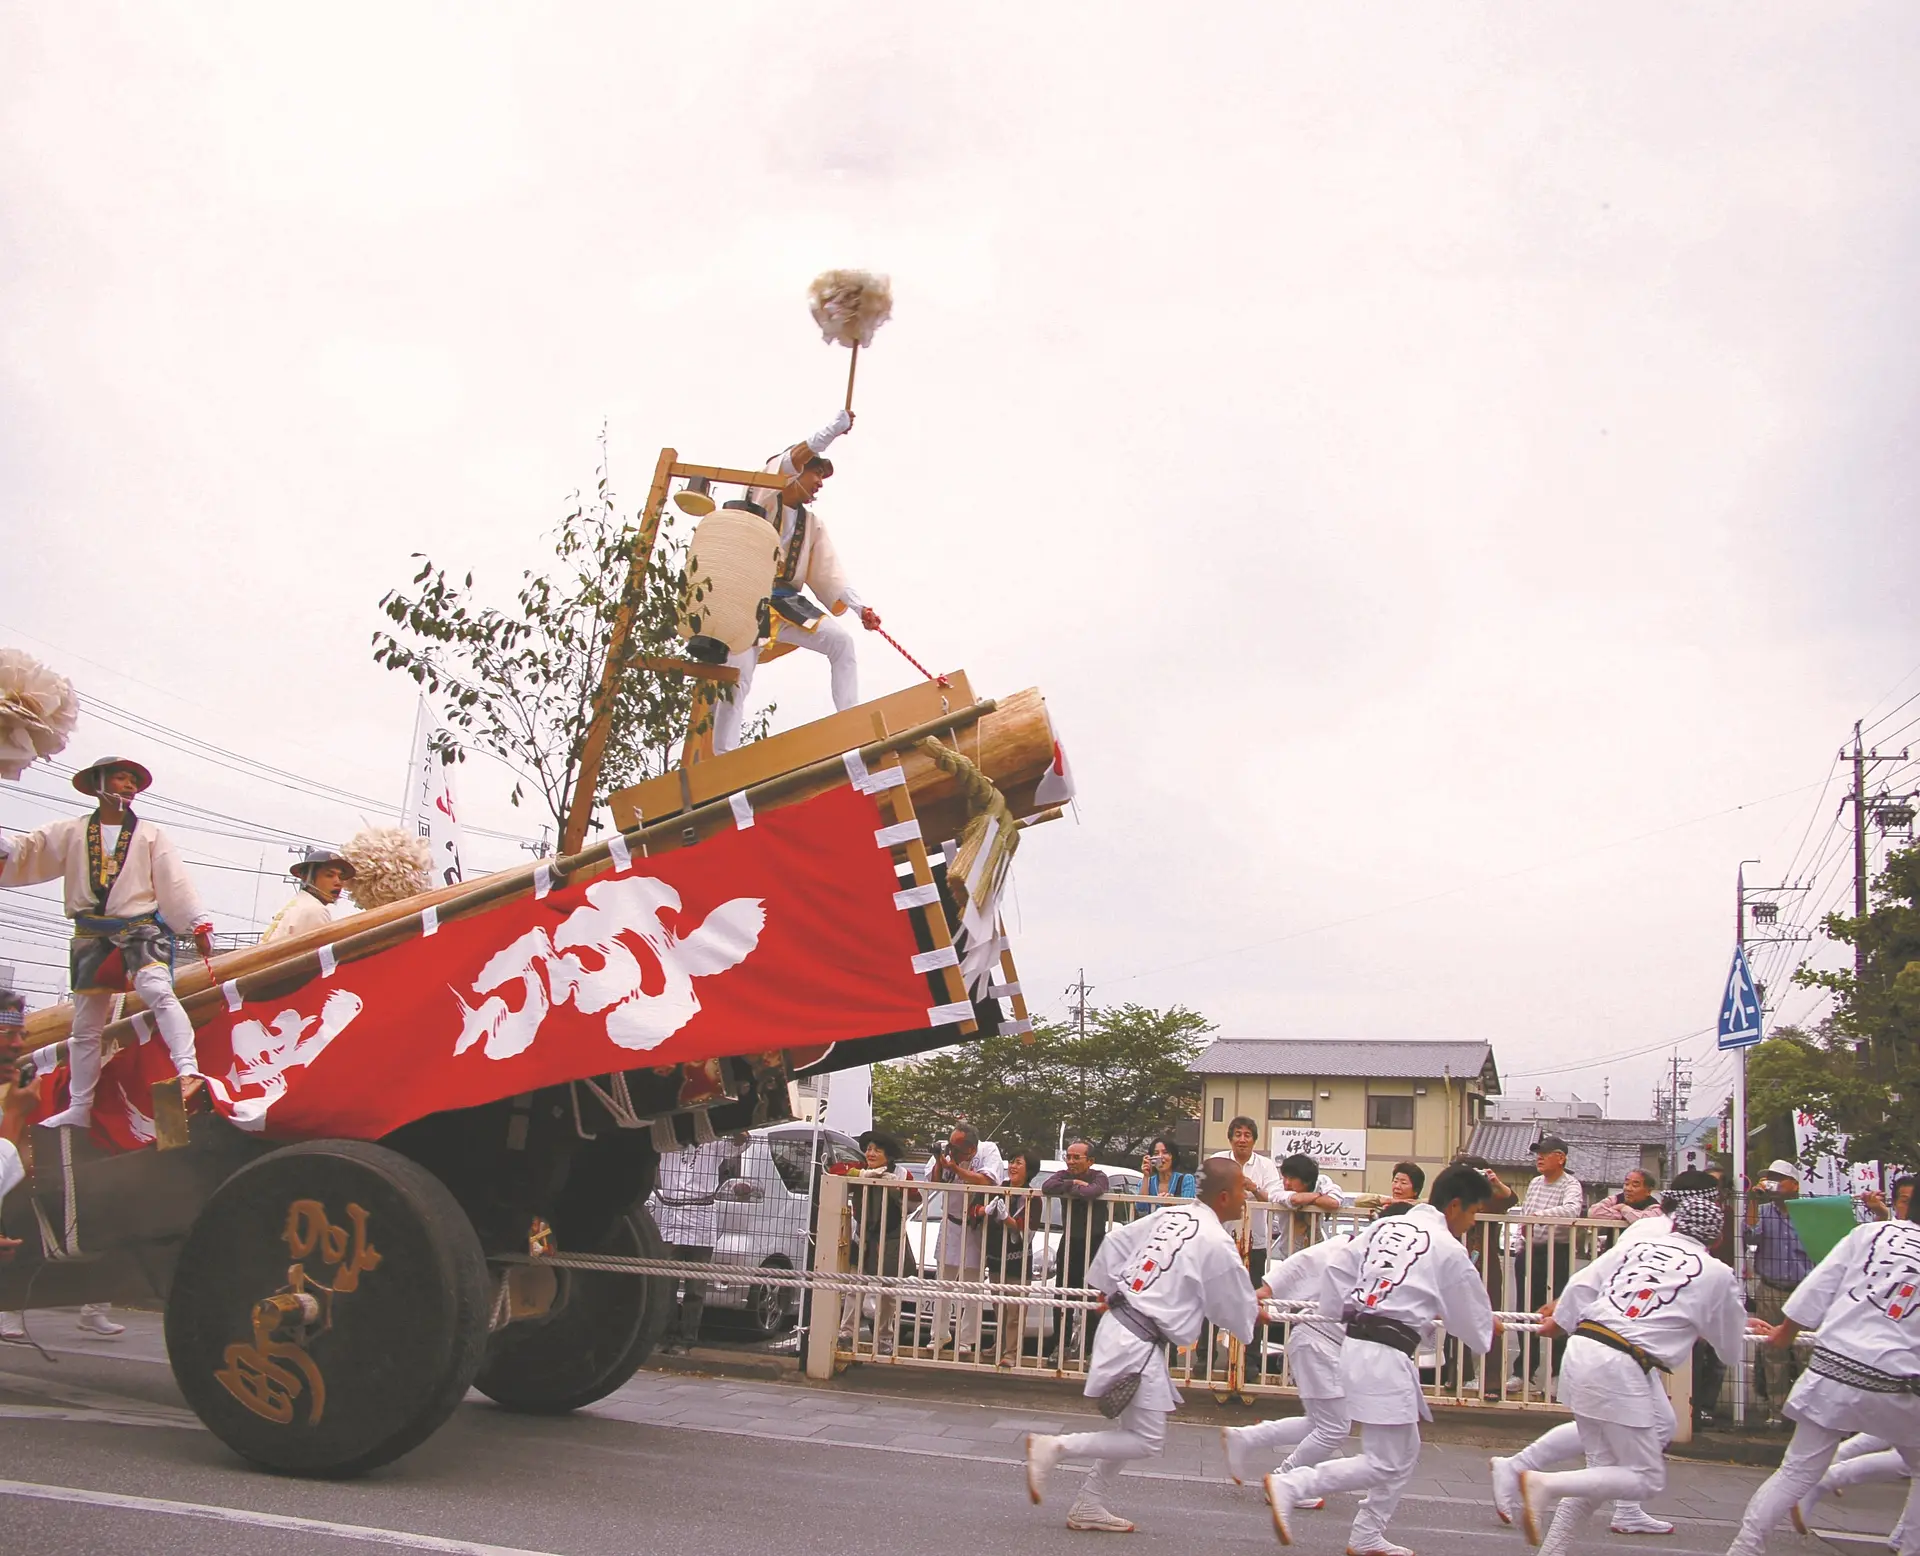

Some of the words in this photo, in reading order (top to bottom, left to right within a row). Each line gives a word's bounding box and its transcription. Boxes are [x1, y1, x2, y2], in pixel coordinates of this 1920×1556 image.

[1286, 1137, 1351, 1156] 伊勢うどん
